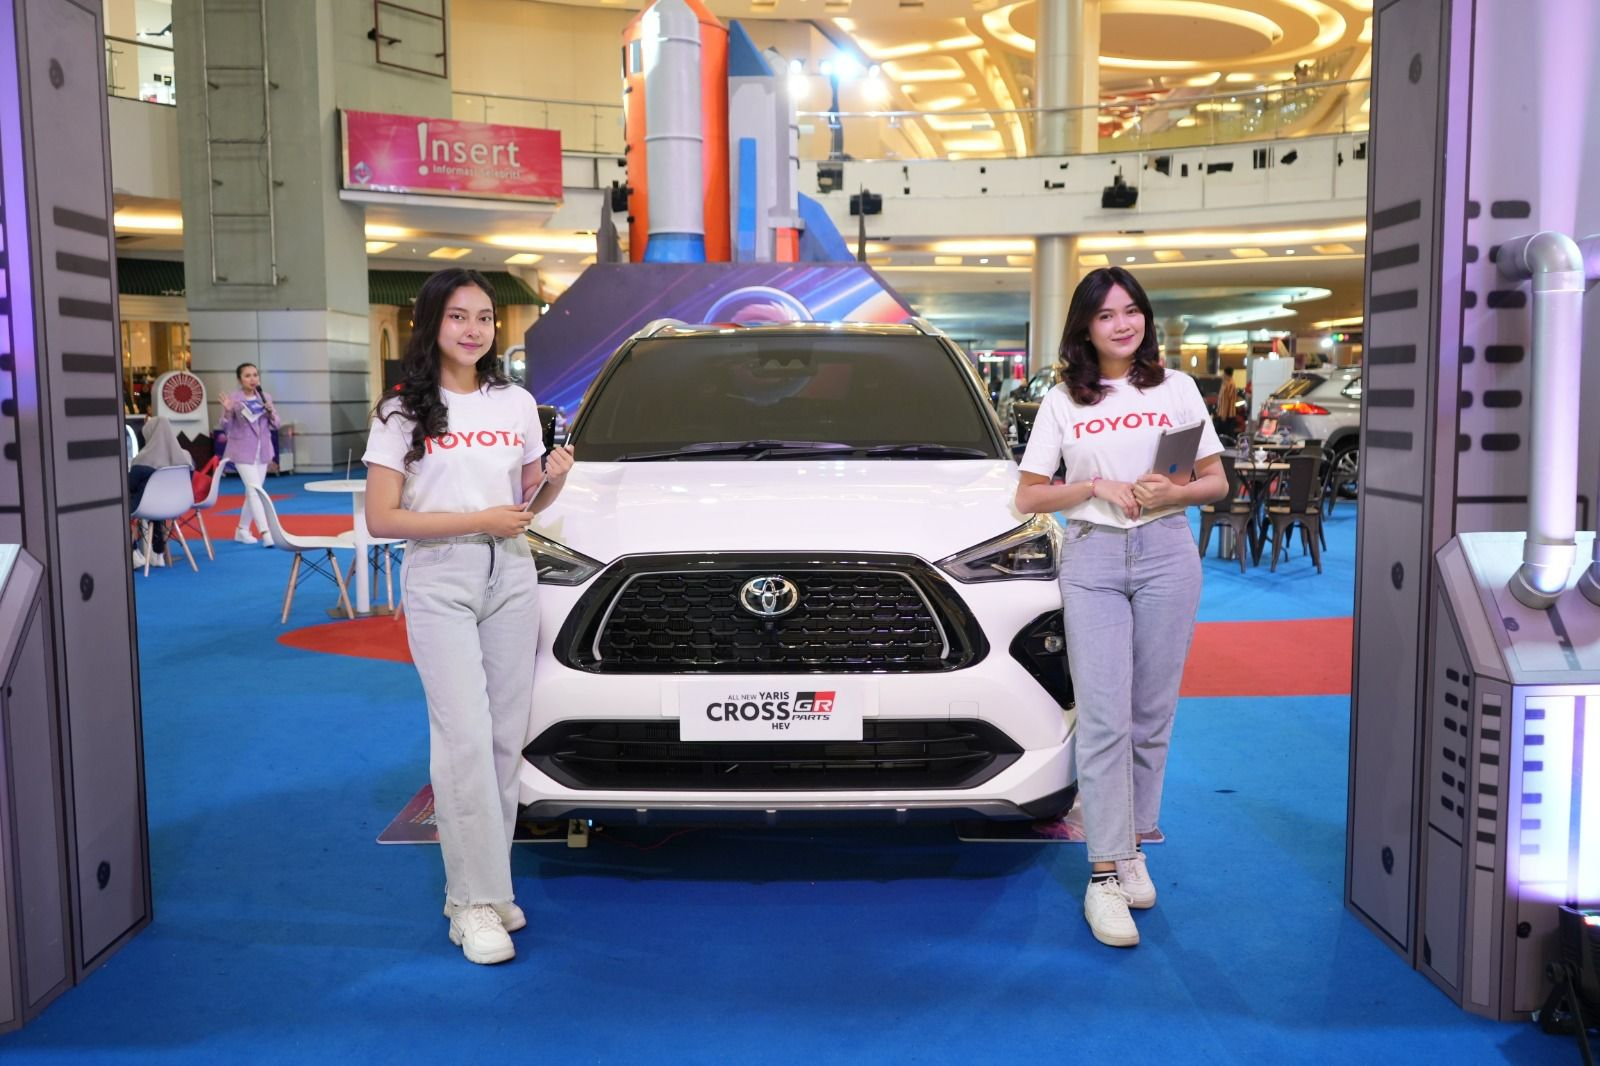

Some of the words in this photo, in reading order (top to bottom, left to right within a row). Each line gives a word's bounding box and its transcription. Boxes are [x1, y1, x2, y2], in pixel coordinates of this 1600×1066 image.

[1073, 412, 1173, 439] TOYOTA
[759, 691, 790, 700] YARIS
[706, 702, 790, 721] CROSS
[771, 722, 791, 730] HEV
